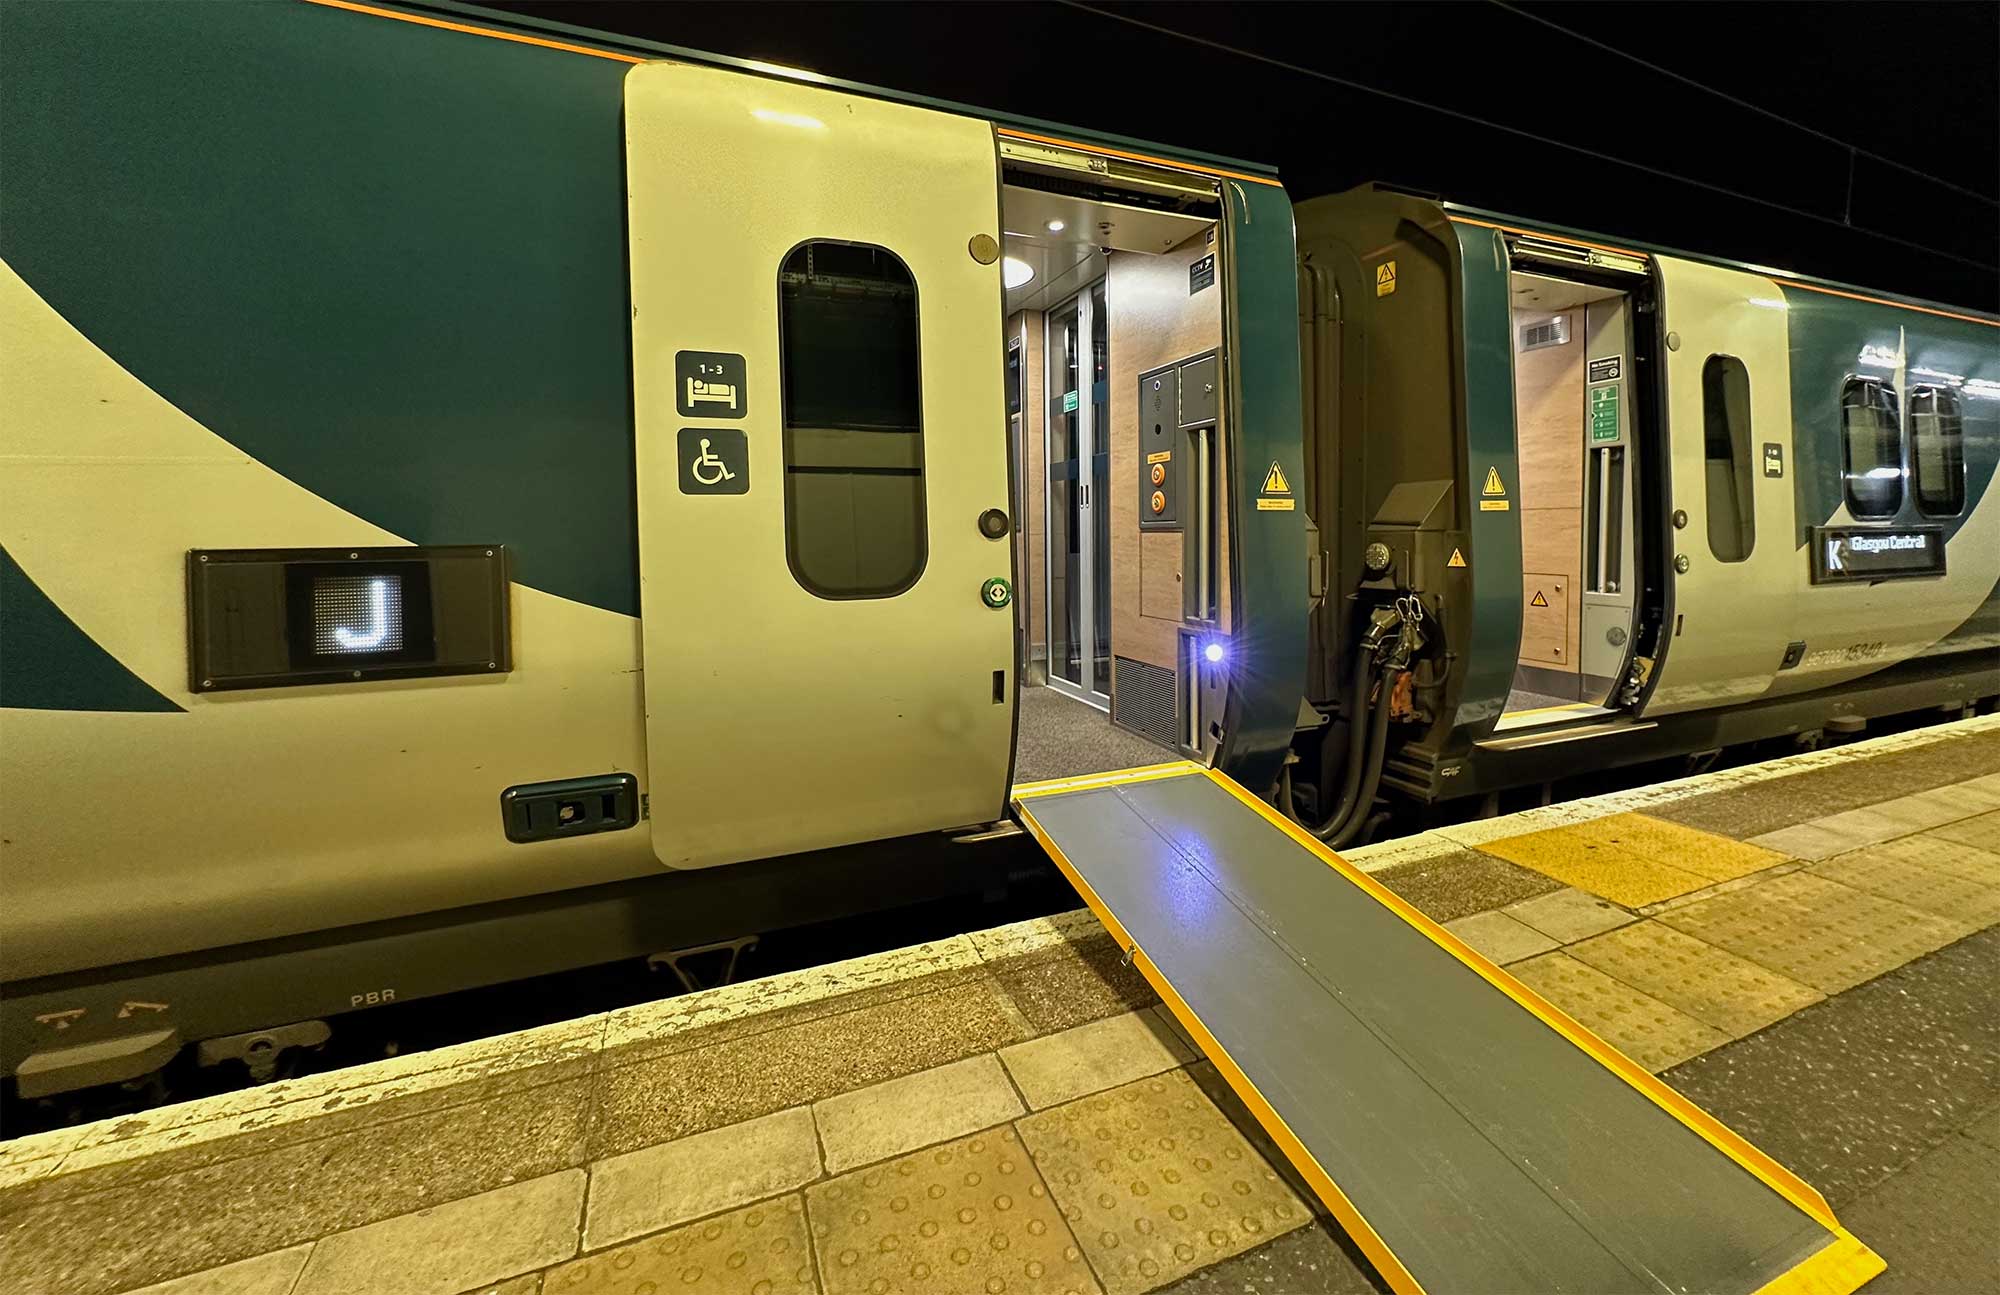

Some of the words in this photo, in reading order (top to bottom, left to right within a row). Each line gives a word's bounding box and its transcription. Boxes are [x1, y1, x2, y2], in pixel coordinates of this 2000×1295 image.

[1890, 534, 1926, 549] Central
[1828, 540, 1843, 570] K
[335, 579, 386, 649] J
[351, 989, 396, 1008] PBR
